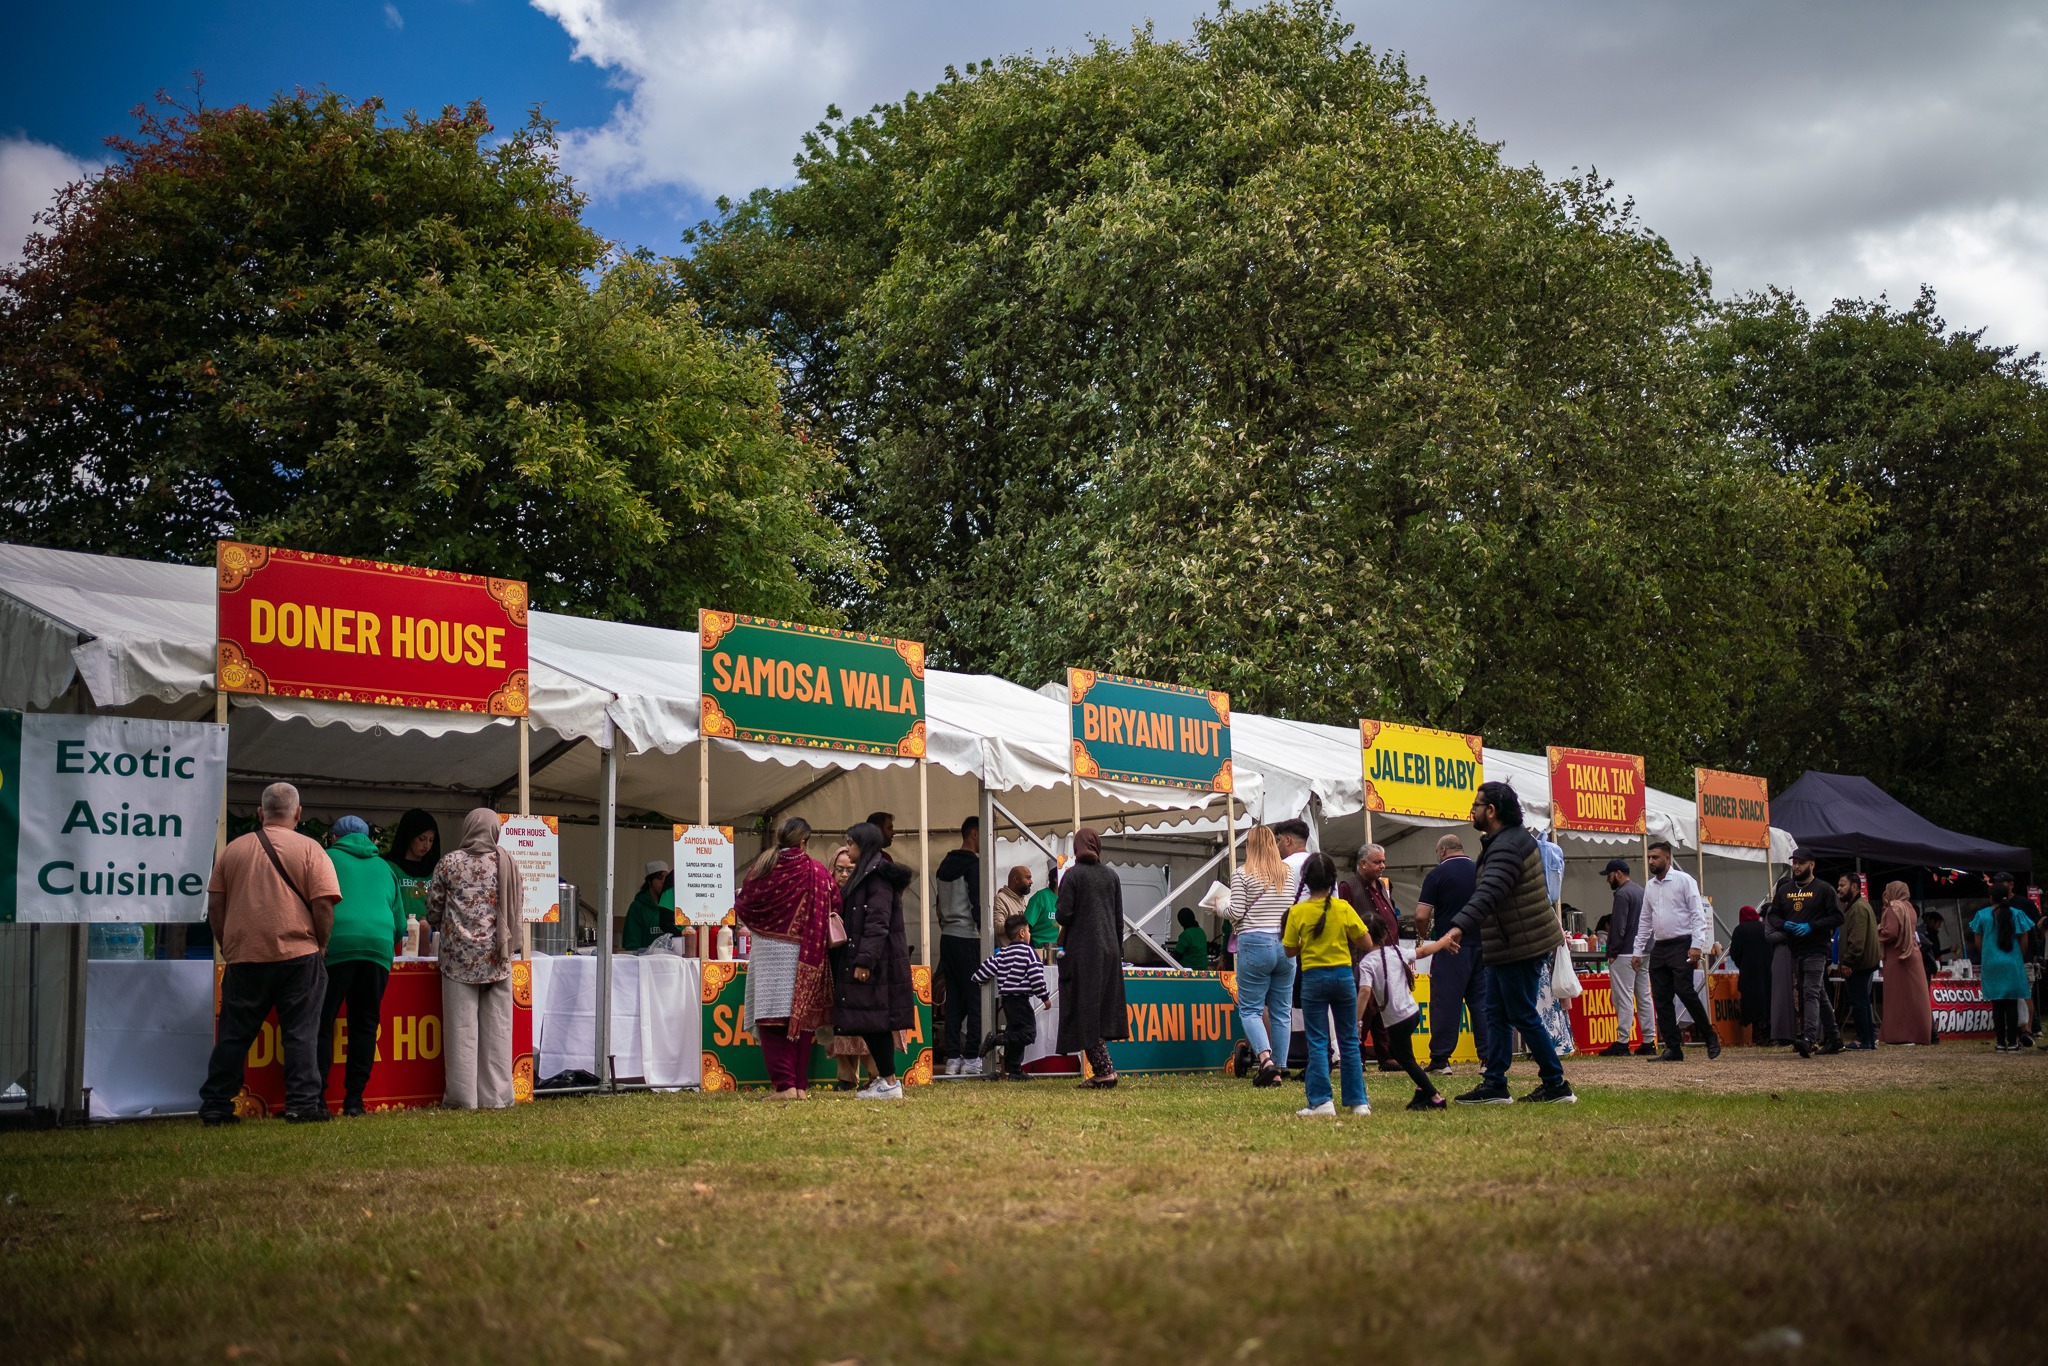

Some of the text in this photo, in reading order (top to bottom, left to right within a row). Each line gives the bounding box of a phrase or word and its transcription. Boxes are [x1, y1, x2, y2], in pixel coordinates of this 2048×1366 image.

[251, 599, 506, 669] DONER HOUSE
[712, 651, 918, 716] SAMOSA WALA
[1083, 702, 1222, 758] BIRYANI HUT
[56, 739, 195, 780] Exotic
[1369, 748, 1476, 791] JALEBI BABY
[1566, 762, 1635, 796] TAKKA TAK
[60, 800, 182, 837] Asian
[1575, 791, 1627, 821] DONNER
[1703, 793, 1766, 822] BURGER SHACK
[505, 827, 546, 837] DONER HOUSE
[518, 839, 534, 848] MENU
[684, 836, 706, 845] SAMOSA
[37, 860, 204, 896] Cuisine
[1581, 988, 1616, 1016] TAKK
[1714, 998, 1740, 1021] BURG
[1191, 1003, 1235, 1041] HUT
